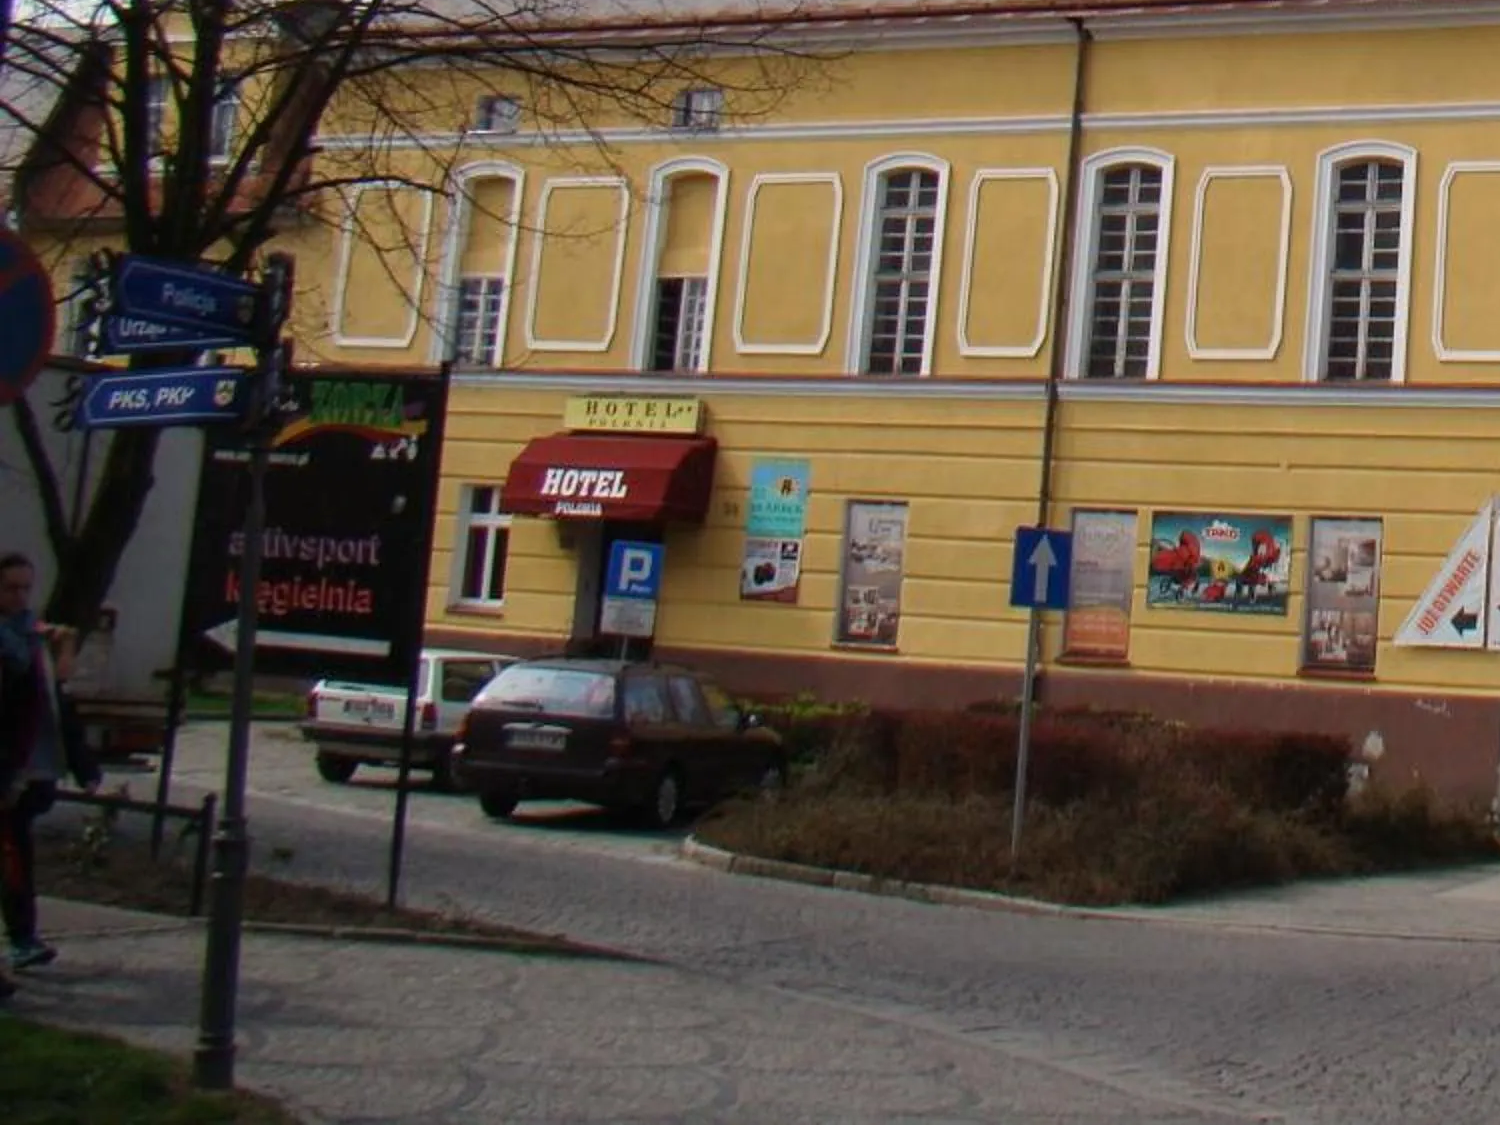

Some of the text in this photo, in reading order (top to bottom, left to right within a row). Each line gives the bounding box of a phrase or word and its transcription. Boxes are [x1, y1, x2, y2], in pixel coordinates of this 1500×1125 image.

[108, 388, 151, 411] PKS,
[585, 399, 676, 419] HOTEL
[540, 467, 629, 499] HOTEL
[554, 499, 604, 516] POLONIA
[228, 526, 383, 568] ativsport
[618, 547, 654, 591] P
[1434, 547, 1483, 613] OTWARTE
[225, 570, 374, 615] kęgielnia
